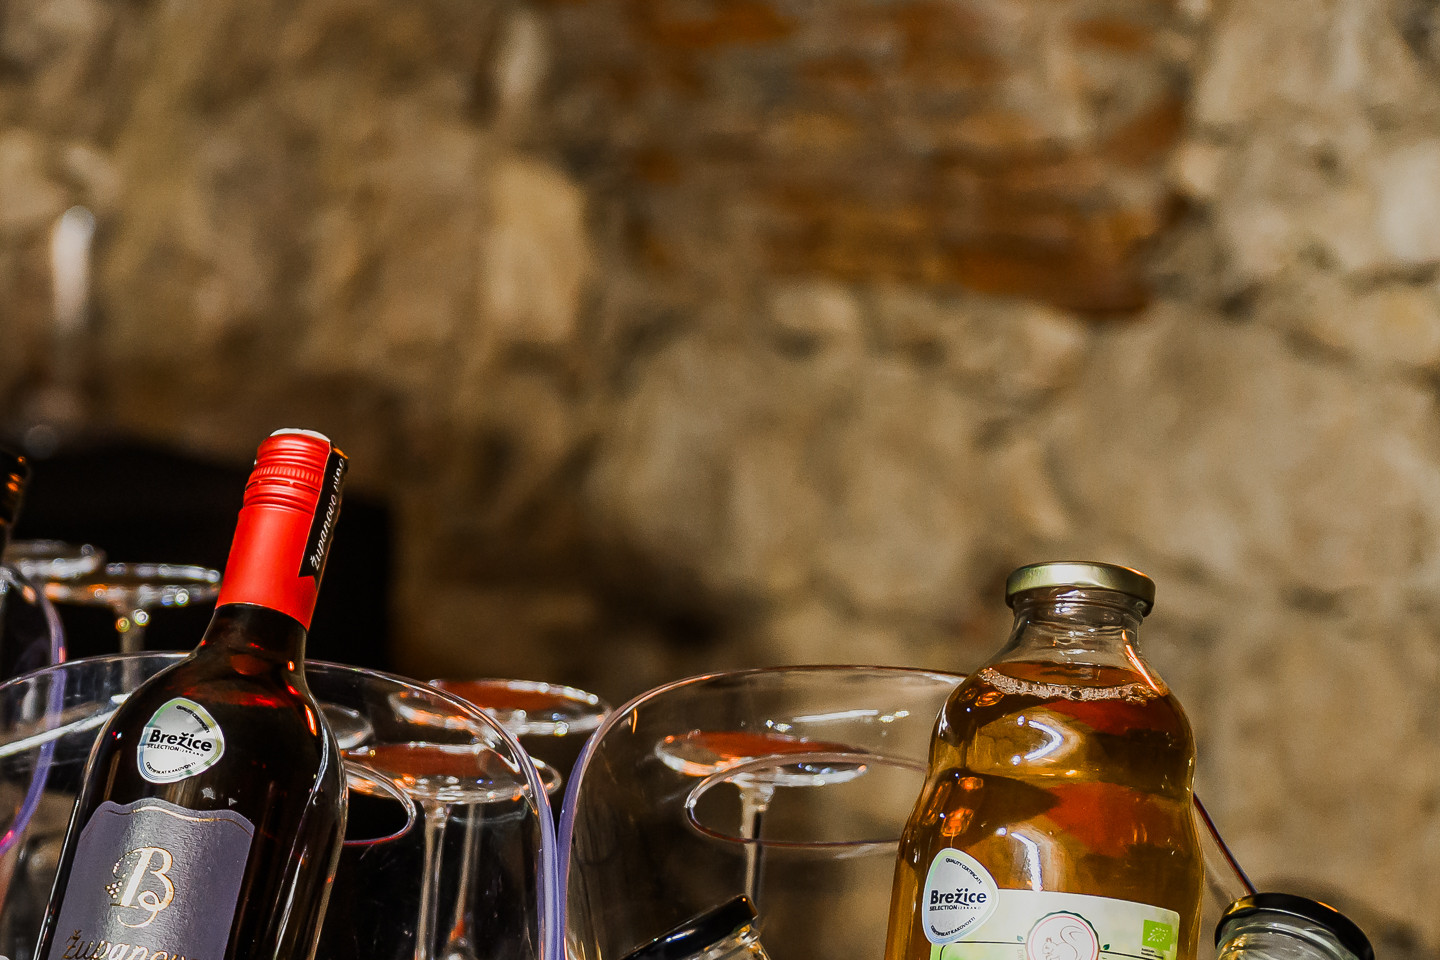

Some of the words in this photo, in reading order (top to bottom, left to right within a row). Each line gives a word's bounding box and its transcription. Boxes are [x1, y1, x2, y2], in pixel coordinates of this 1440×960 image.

[146, 743, 180, 752] SELECTION
[149, 729, 212, 752] Brežice
[930, 888, 987, 907] Brežice
